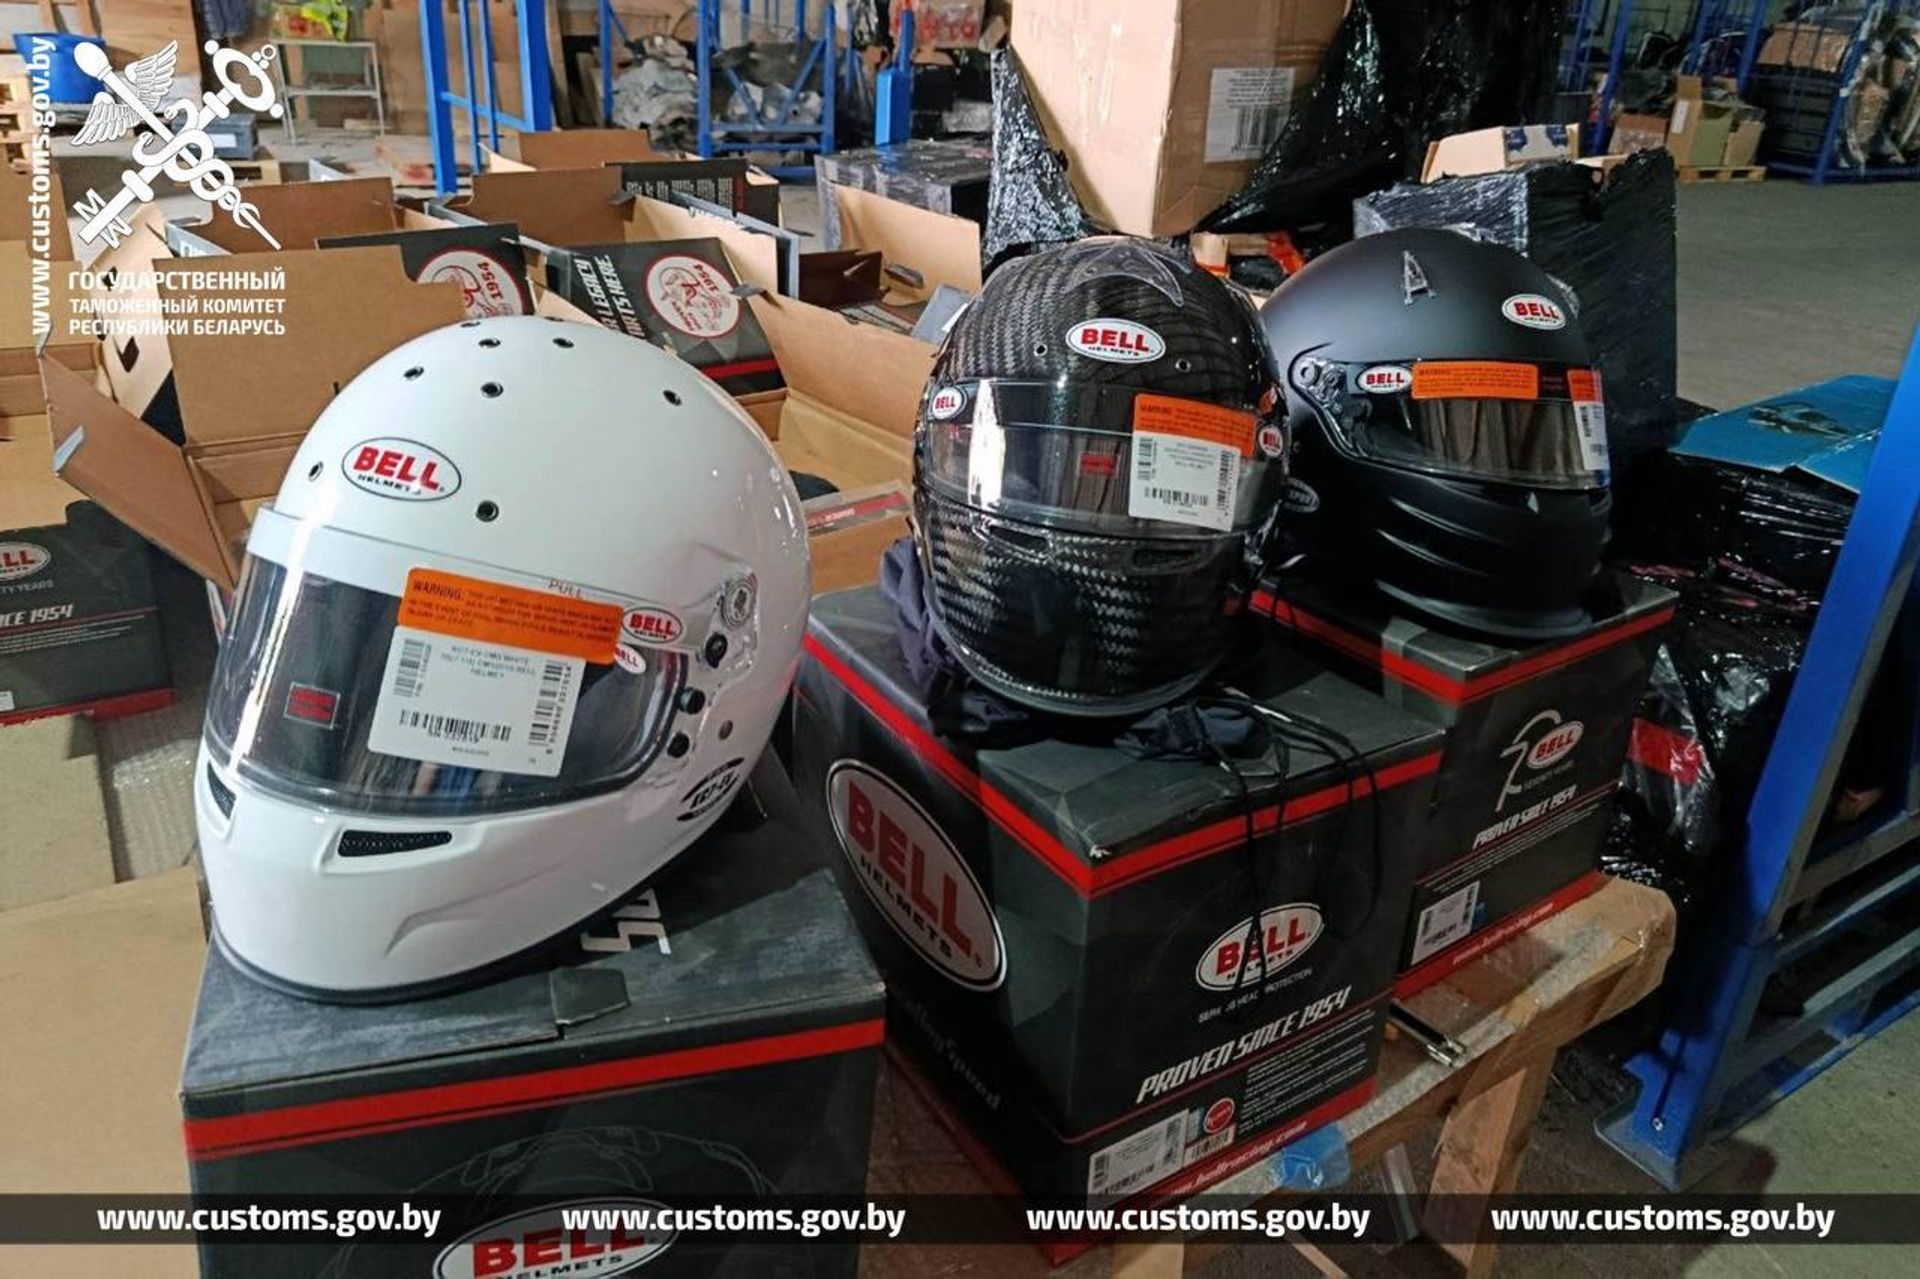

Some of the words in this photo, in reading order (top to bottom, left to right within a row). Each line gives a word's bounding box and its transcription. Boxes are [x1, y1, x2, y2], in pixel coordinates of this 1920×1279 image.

[1513, 301, 1560, 322] BELL
[1081, 328, 1150, 352] BELL
[1366, 373, 1405, 386] BELL
[935, 396, 957, 409] BELL
[353, 446, 440, 491] BELL
[18, 579, 53, 592] YEARS
[548, 580, 583, 599] PULL
[30, 603, 74, 624] 1954
[630, 613, 674, 635] BELL
[1535, 730, 1574, 759] BELL
[848, 779, 974, 956] BELL
[859, 856, 952, 959] HELMETS
[1136, 1041, 1233, 1104] PROVEN
[1232, 1011, 1300, 1061] SINCE
[1298, 985, 1352, 1030] 1954
[473, 1216, 645, 1277] BELL
[497, 1255, 622, 1279] ELMETS
